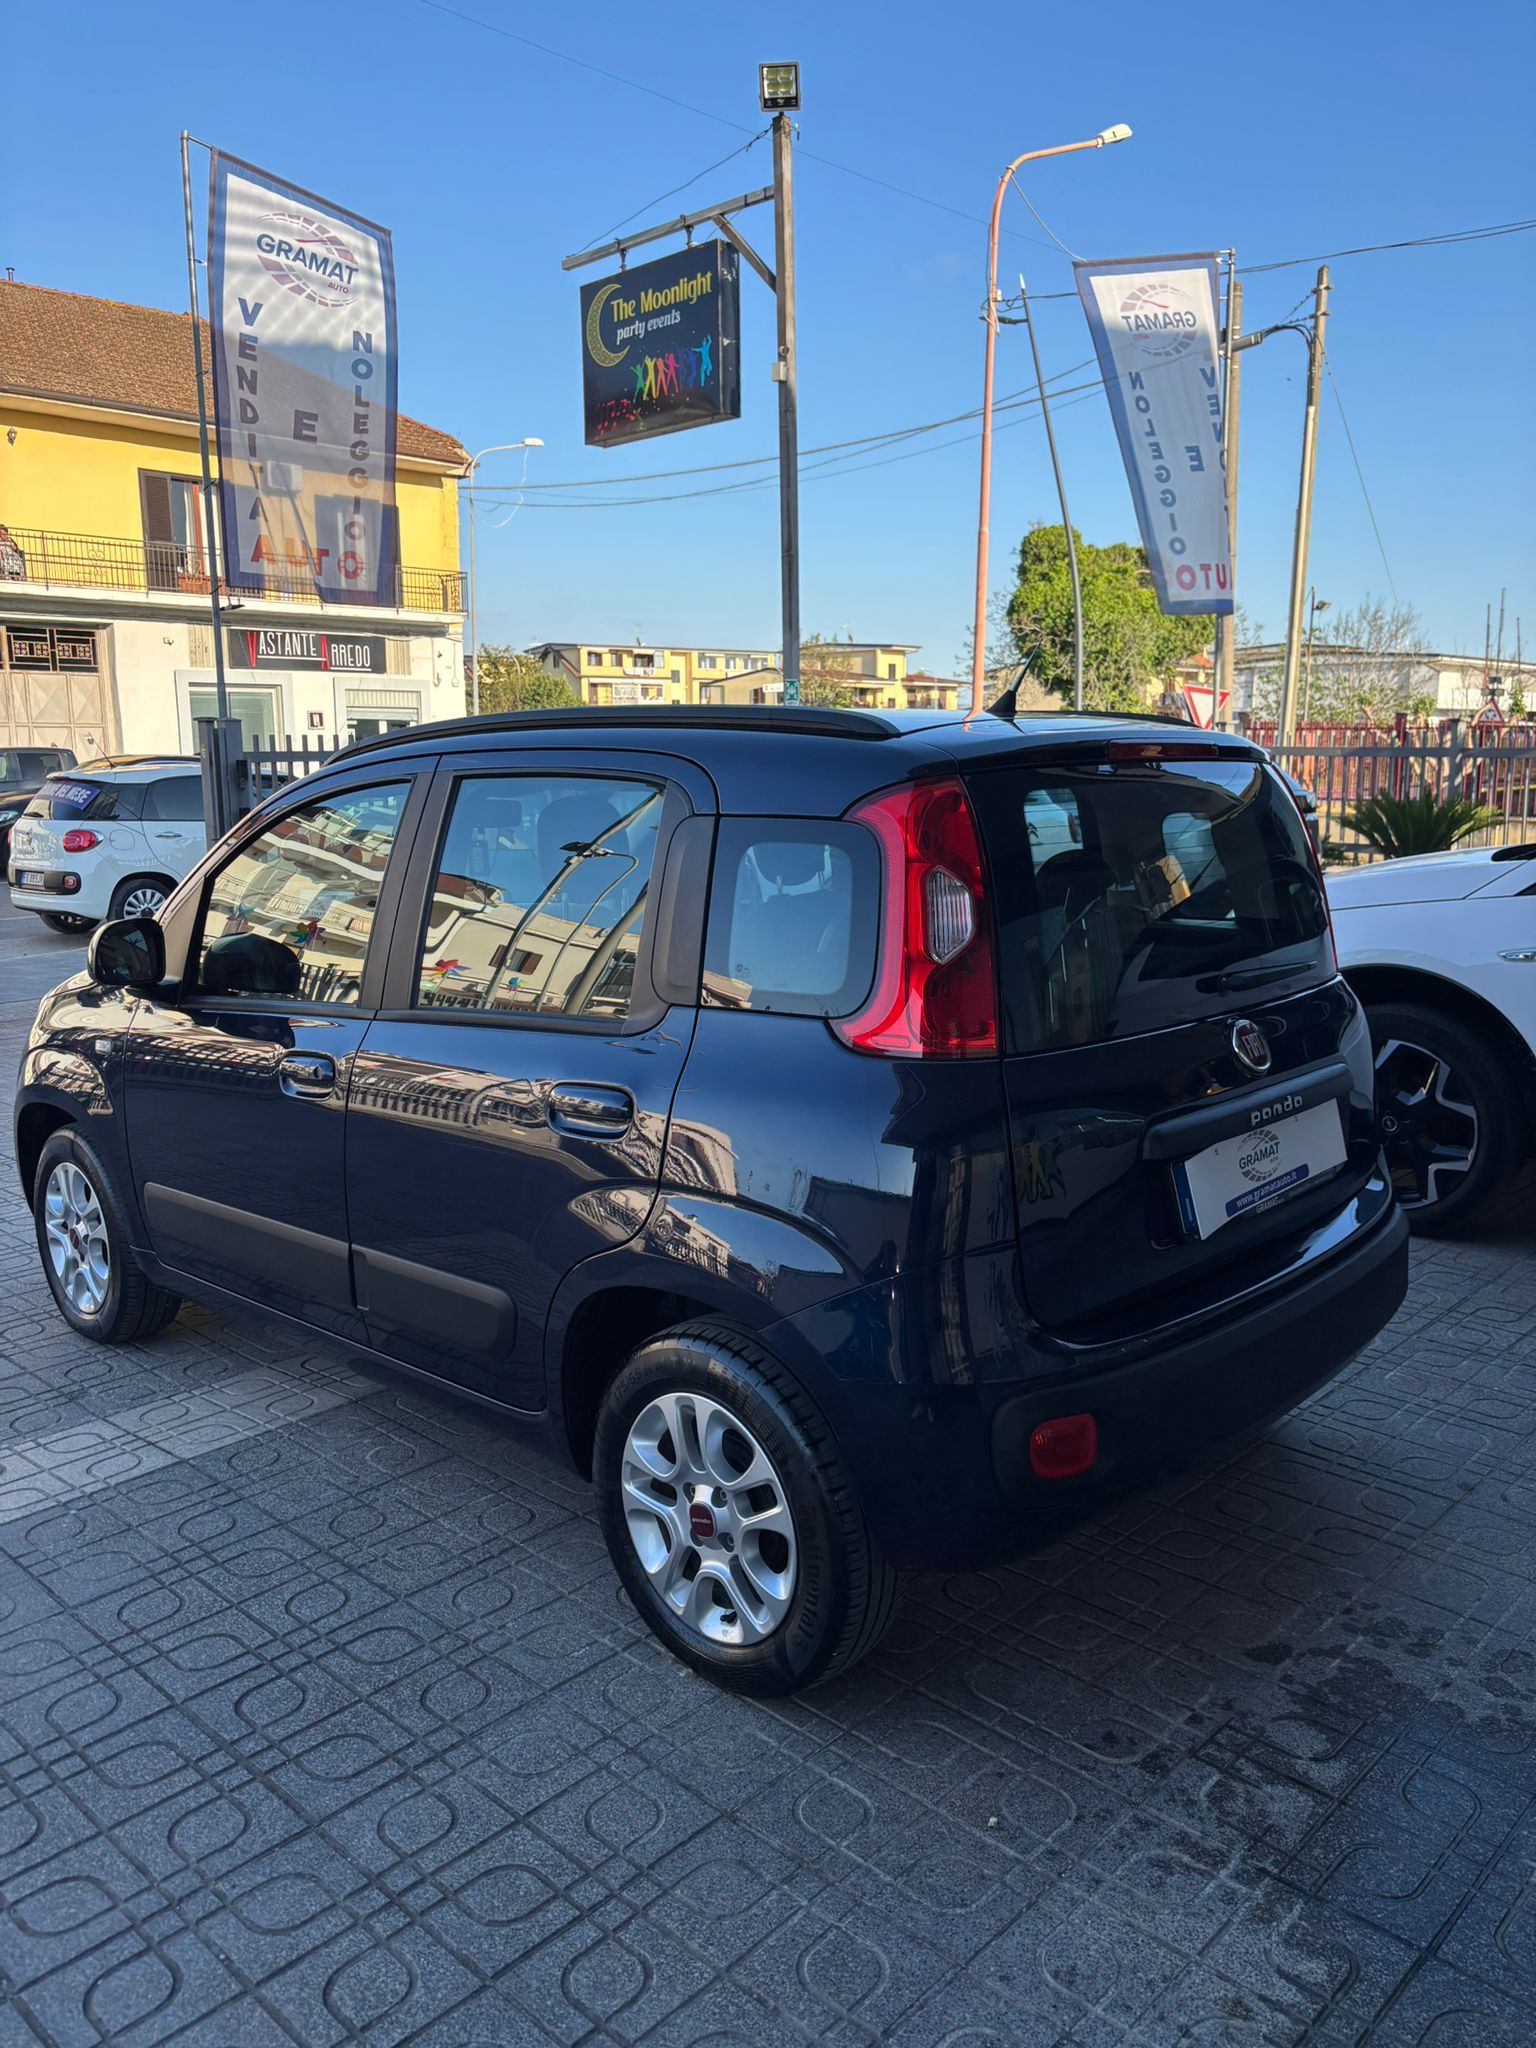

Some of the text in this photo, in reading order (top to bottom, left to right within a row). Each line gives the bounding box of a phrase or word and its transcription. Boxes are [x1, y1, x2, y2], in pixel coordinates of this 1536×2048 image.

[256, 233, 359, 285] GRAMAT
[327, 281, 349, 294] AUTO
[610, 271, 713, 322] The Moonlight
[616, 309, 681, 346] party events
[236, 296, 268, 523] VENDITA
[293, 409, 318, 443] E
[344, 330, 373, 540] NOLEGGIO
[250, 533, 364, 580] AUTO
[247, 631, 371, 670] VASTANTE ARREDO
[1250, 1095, 1303, 1126] panda
[1239, 1141, 1280, 1170] GRAMAT
[1236, 1171, 1297, 1208] www.gramatauto.it
